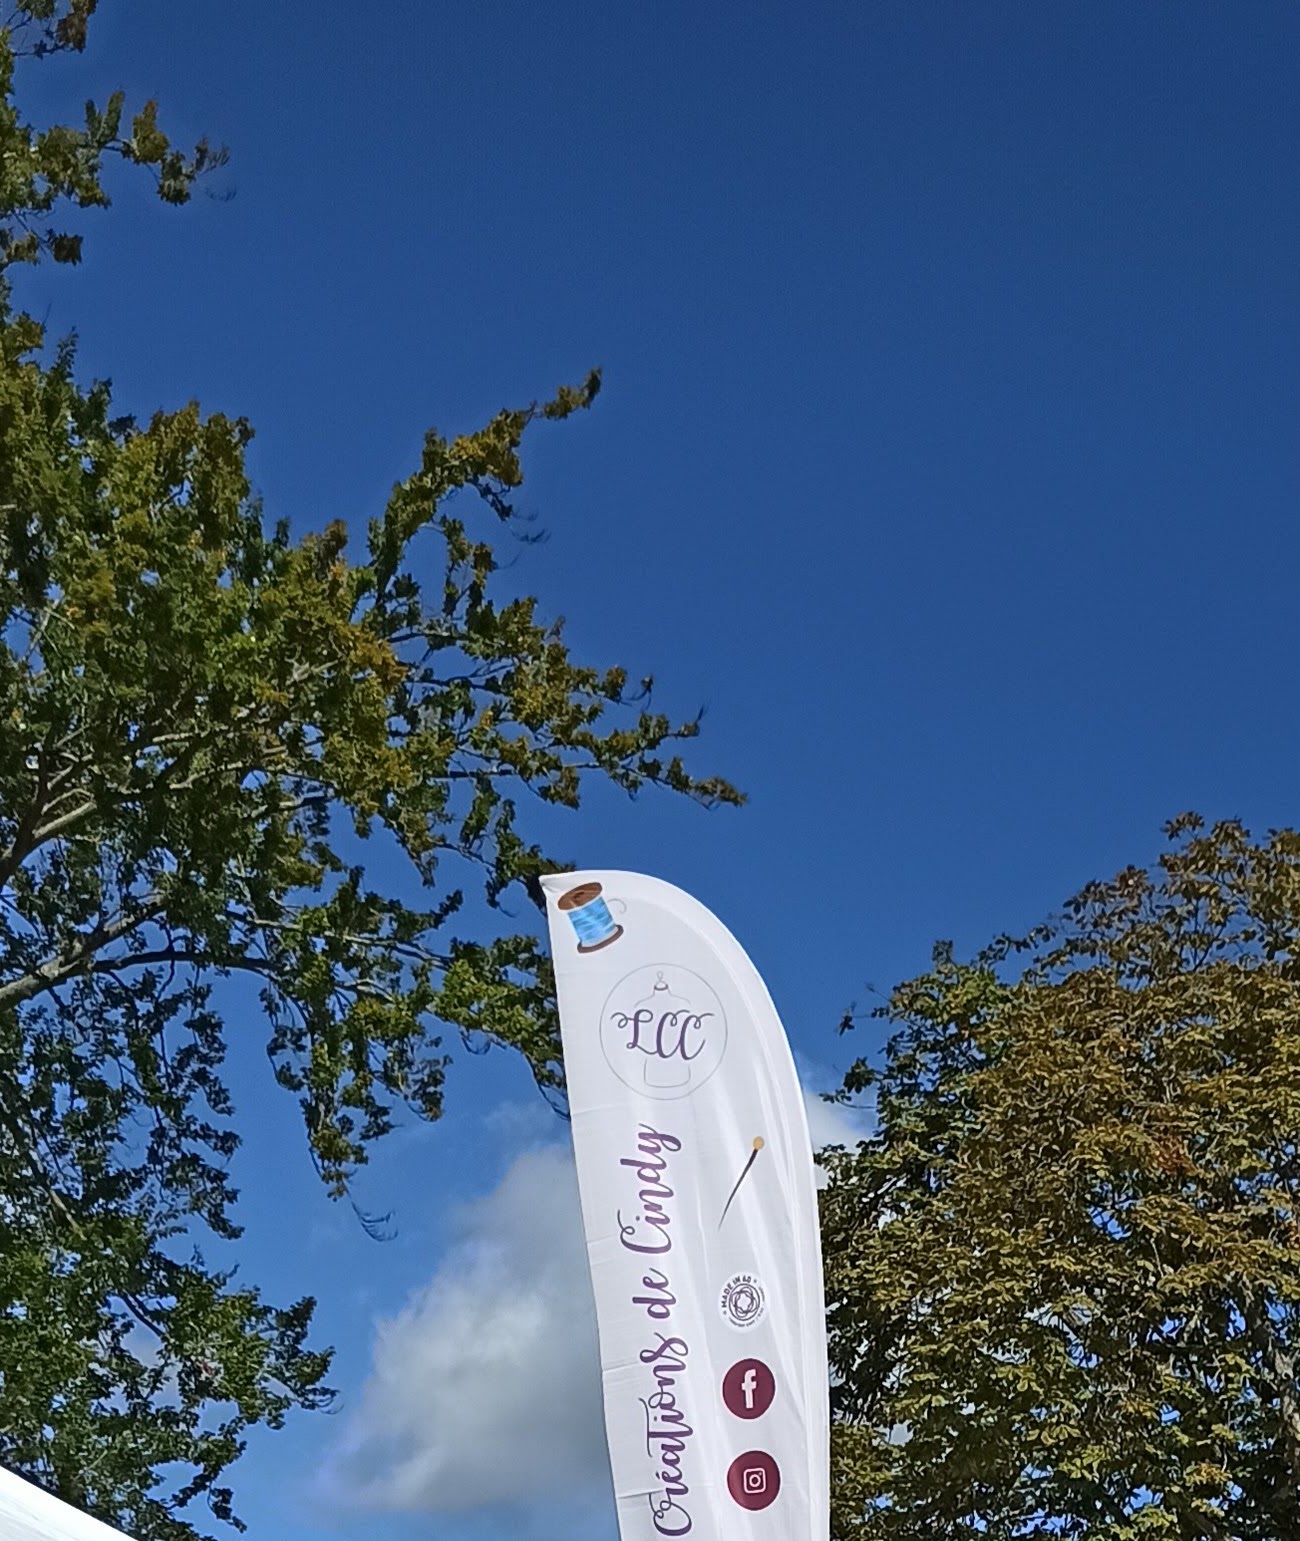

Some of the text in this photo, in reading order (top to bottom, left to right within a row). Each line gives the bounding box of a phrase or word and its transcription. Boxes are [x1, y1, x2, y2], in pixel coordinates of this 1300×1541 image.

[611, 1009, 714, 1060] LCC
[617, 1123, 682, 1254] Cindy
[632, 1267, 676, 1319] de
[638, 1332, 693, 1536] Créations
